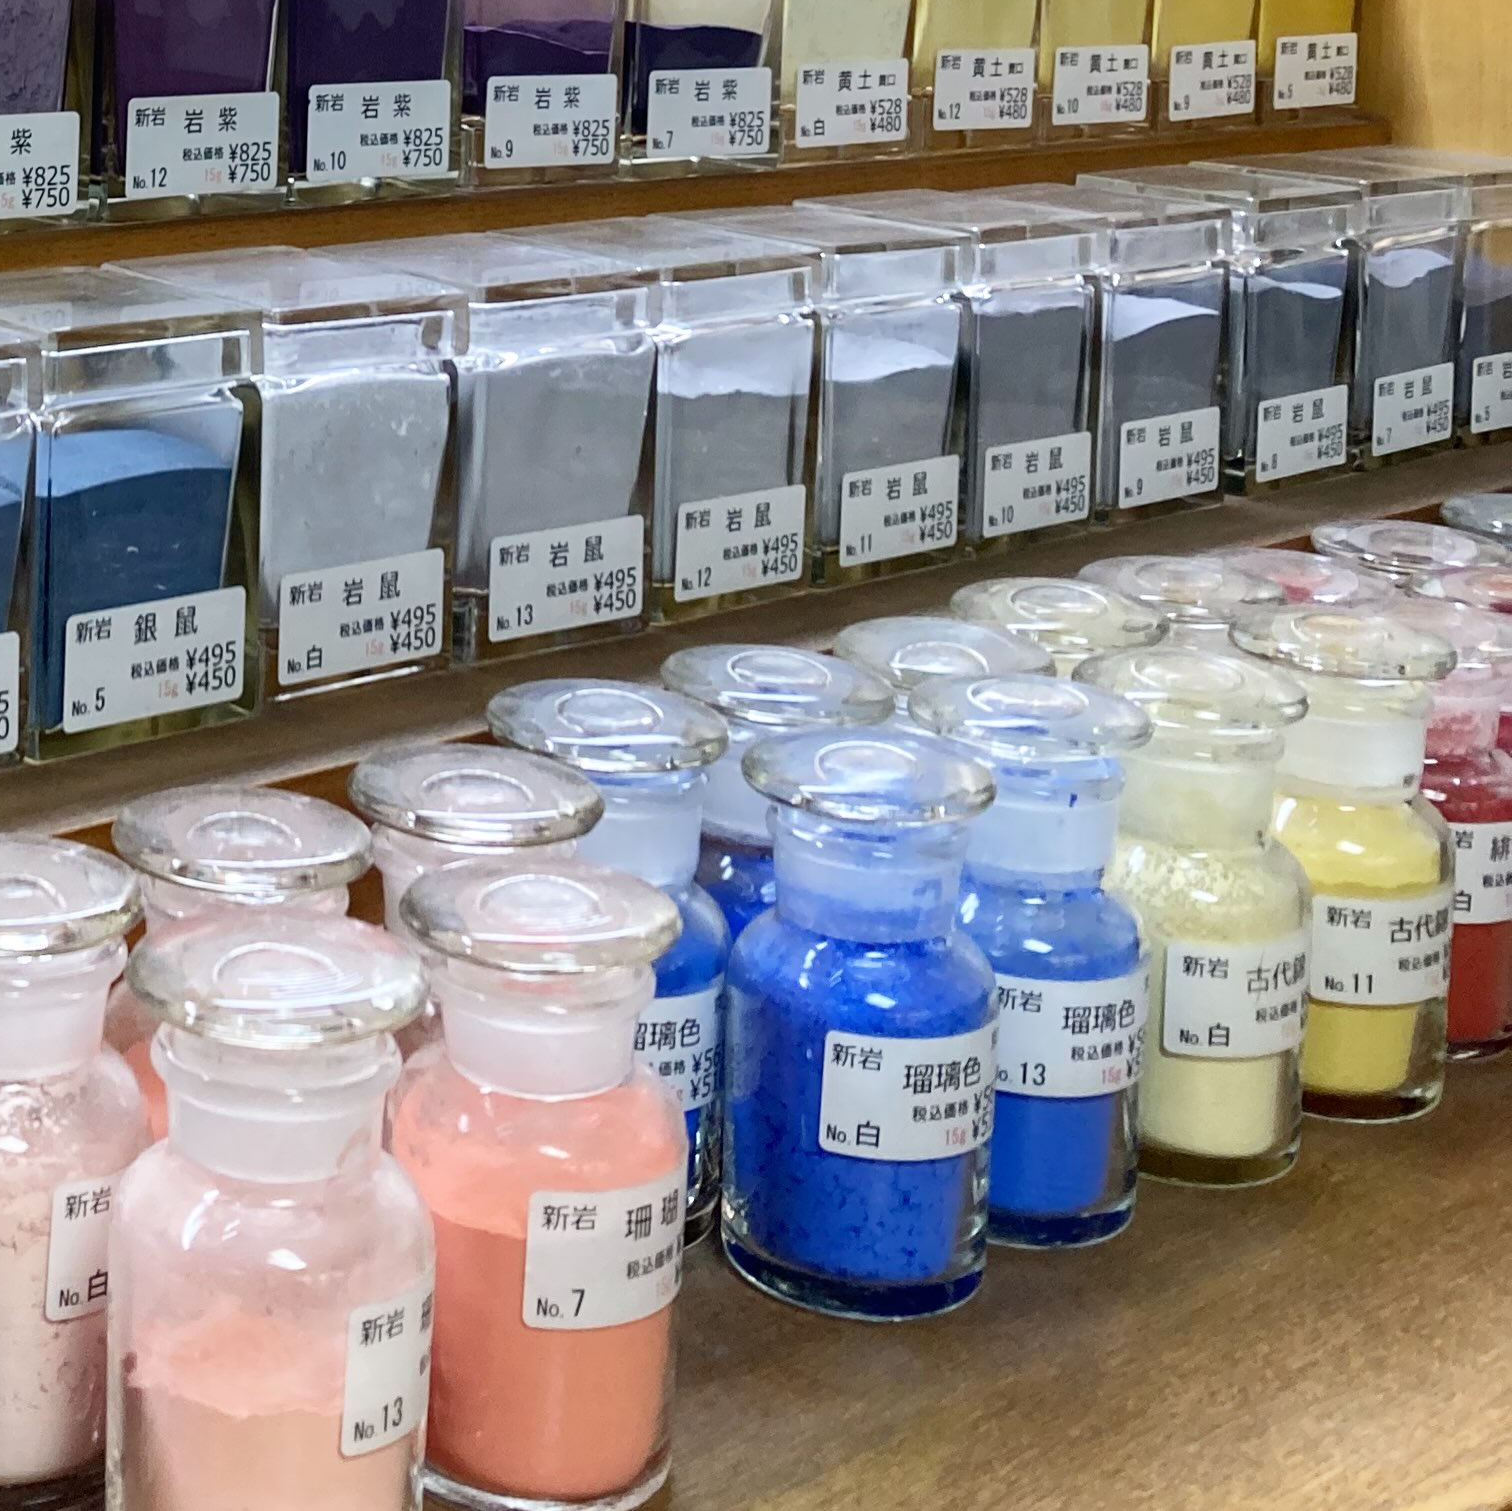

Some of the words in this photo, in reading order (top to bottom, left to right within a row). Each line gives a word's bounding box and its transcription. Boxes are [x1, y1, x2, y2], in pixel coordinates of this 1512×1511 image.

[869, 97, 902, 117] ¥528
[402, 126, 443, 148] ¥825
[21, 163, 70, 188] ¥825
[21, 185, 70, 209] ¥750
[761, 531, 798, 560] ¥495
[288, 580, 322, 606] 新岩
[389, 602, 436, 633] ¥495
[1326, 905, 1372, 930] 新岩
[1182, 955, 1230, 980] 新岩
[1062, 999, 1136, 1036] 瑠璃色
[831, 1043, 884, 1072] 新岩
[902, 1056, 981, 1095] 瑠璃色
[996, 1062, 1047, 1086] o.13
[912, 1099, 969, 1123] 税込価格
[826, 1120, 881, 1149] No.白
[65, 1186, 111, 1221] 新岩
[542, 1204, 597, 1231] 新岩
[536, 1289, 586, 1319] No.7
[361, 1306, 406, 1348] 新岩
[353, 1396, 404, 1443] No.13
